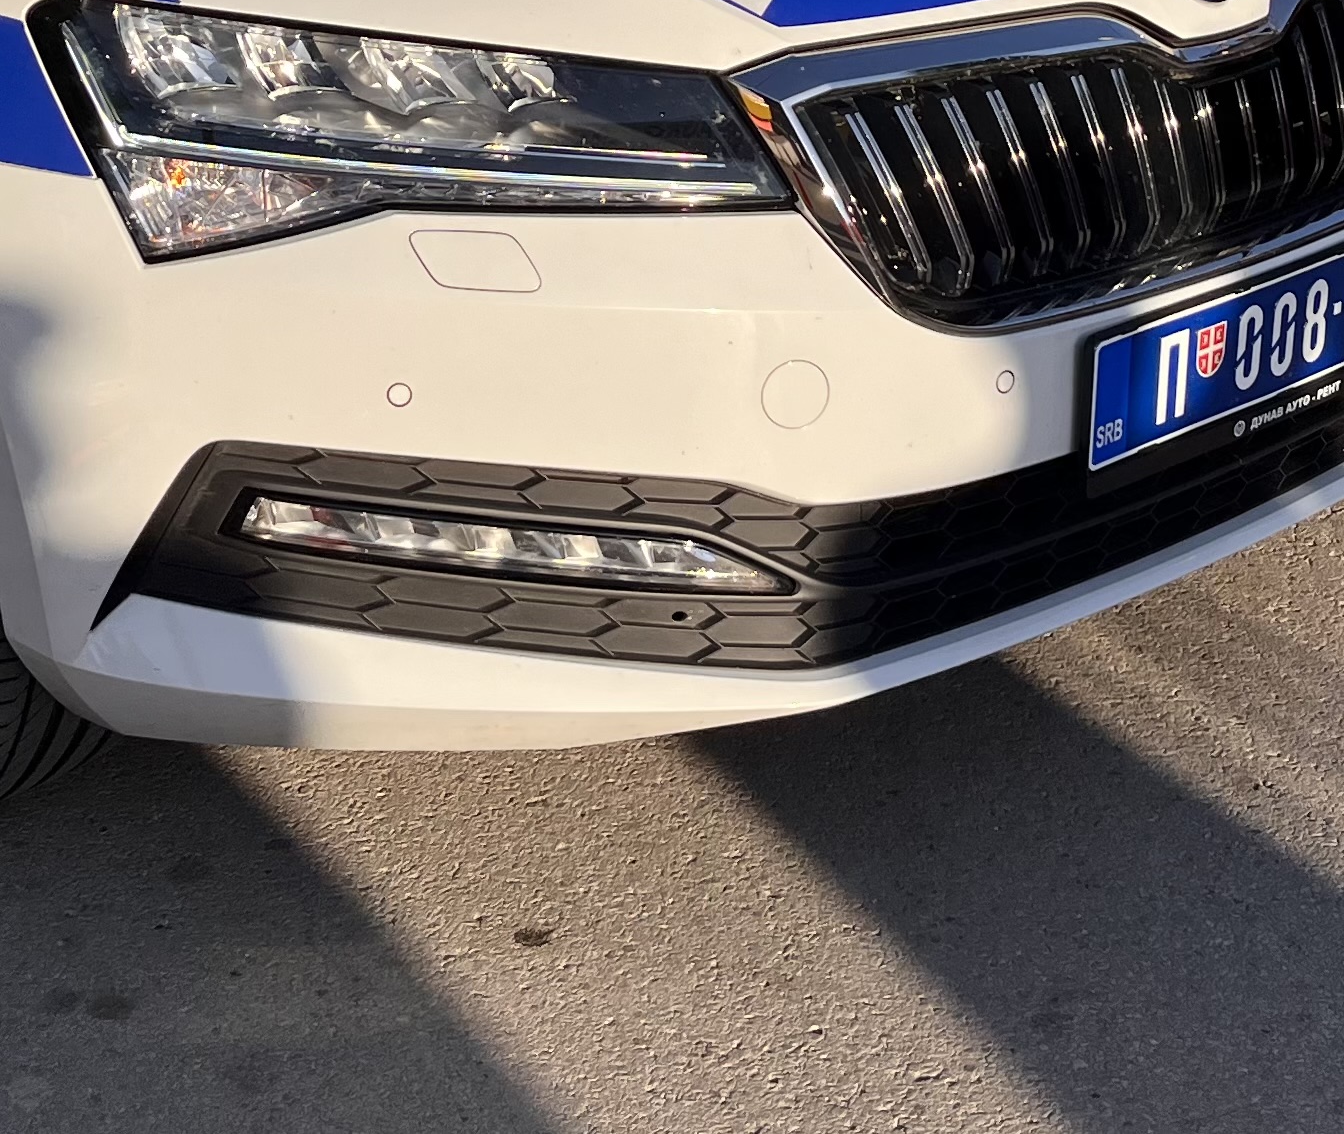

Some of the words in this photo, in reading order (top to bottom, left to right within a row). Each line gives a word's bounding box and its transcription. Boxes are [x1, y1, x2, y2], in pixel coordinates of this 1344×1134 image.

[1155, 327, 1191, 426] П
[1250, 406, 1284, 431] ДУНАВ
[1285, 394, 1311, 414] АУТО
[1316, 379, 1342, 400] РЕНТ
[1094, 417, 1124, 449] SRB
